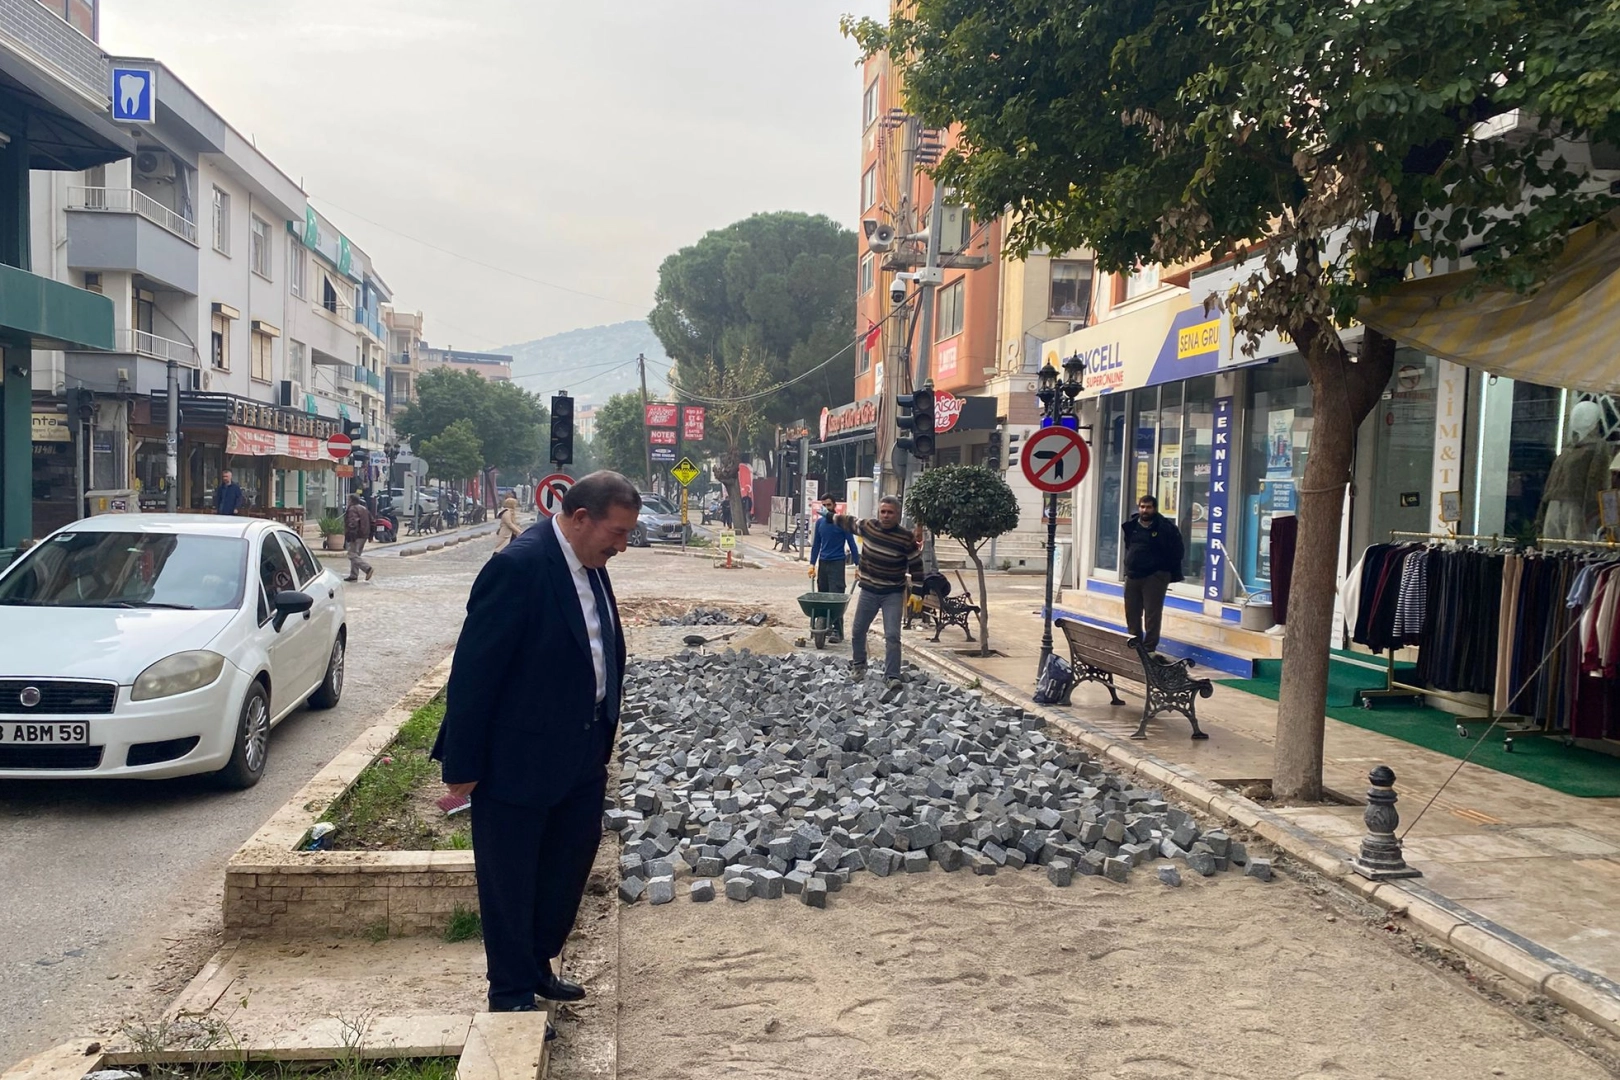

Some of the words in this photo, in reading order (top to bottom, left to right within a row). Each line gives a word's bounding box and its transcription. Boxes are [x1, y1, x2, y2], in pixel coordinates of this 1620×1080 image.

[1180, 331, 1199, 352] SENA
[1063, 342, 1123, 376] KCELL
[651, 431, 675, 439] NOTER
[1213, 401, 1228, 493] TEKNİK
[1208, 506, 1223, 597] SERVİS
[13, 725, 54, 741] ABM
[59, 725, 85, 741] 59
